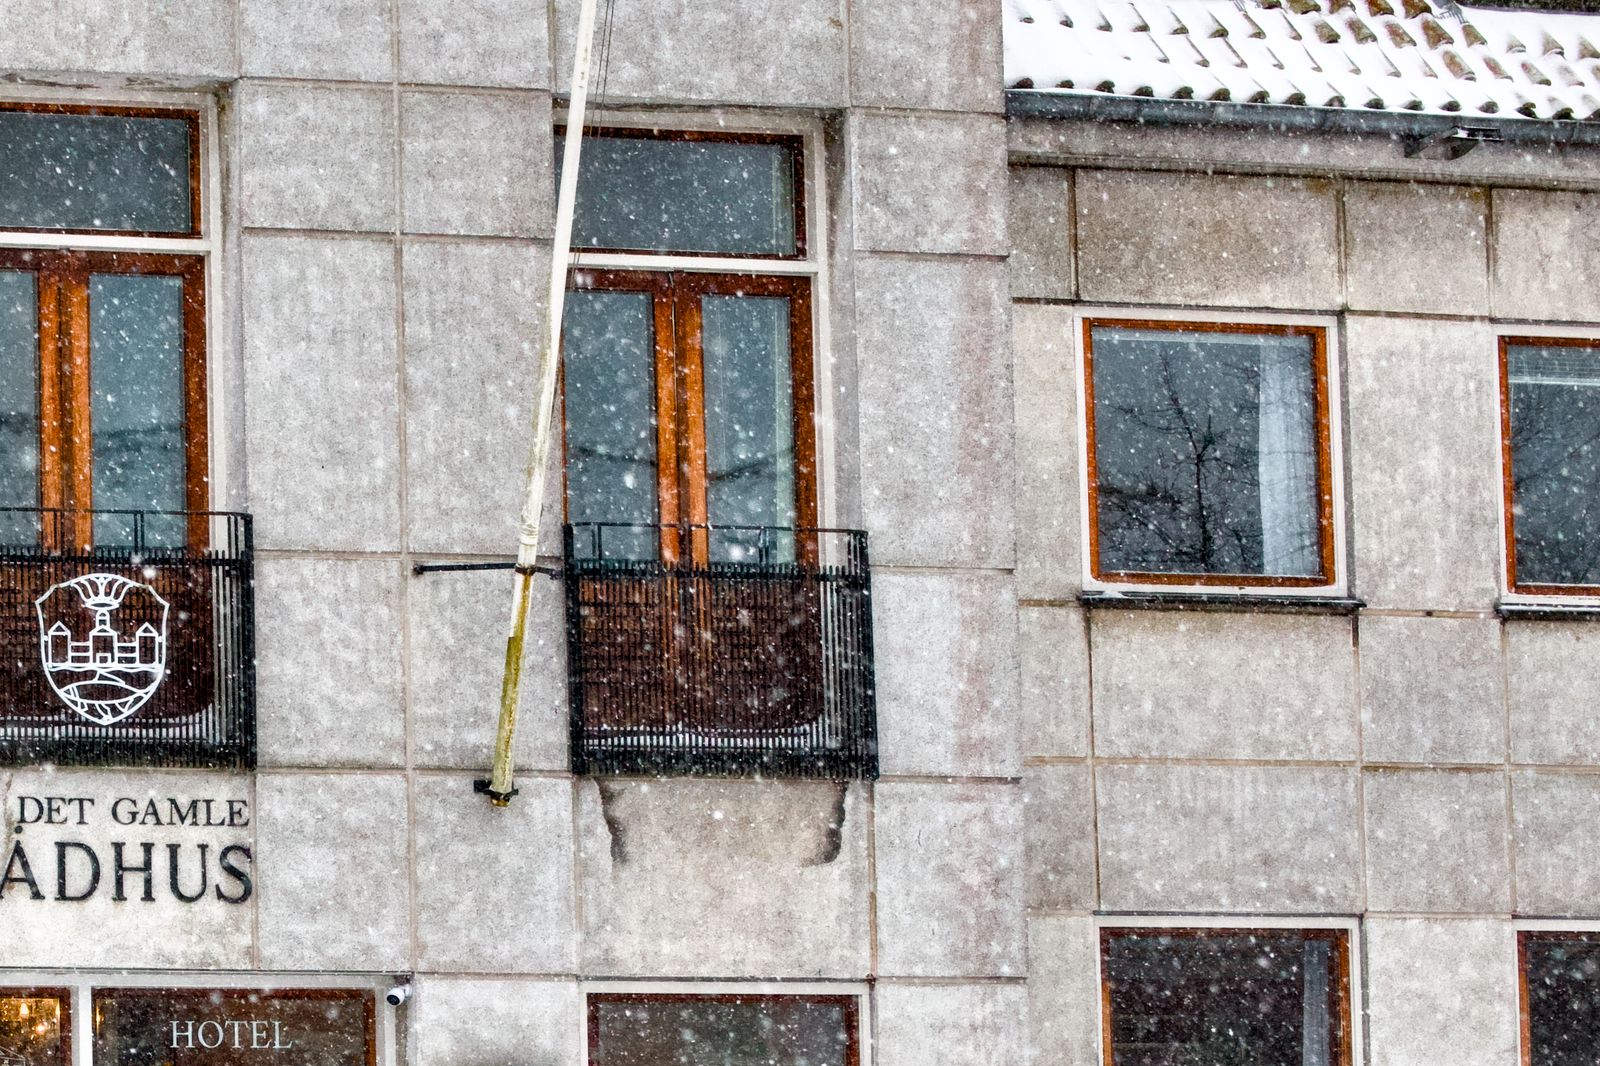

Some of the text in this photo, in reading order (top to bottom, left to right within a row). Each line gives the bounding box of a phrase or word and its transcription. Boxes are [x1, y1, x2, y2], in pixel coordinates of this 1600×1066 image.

[16, 796, 251, 827] DET GAMLE
[169, 1020, 293, 1050] HOTEL
